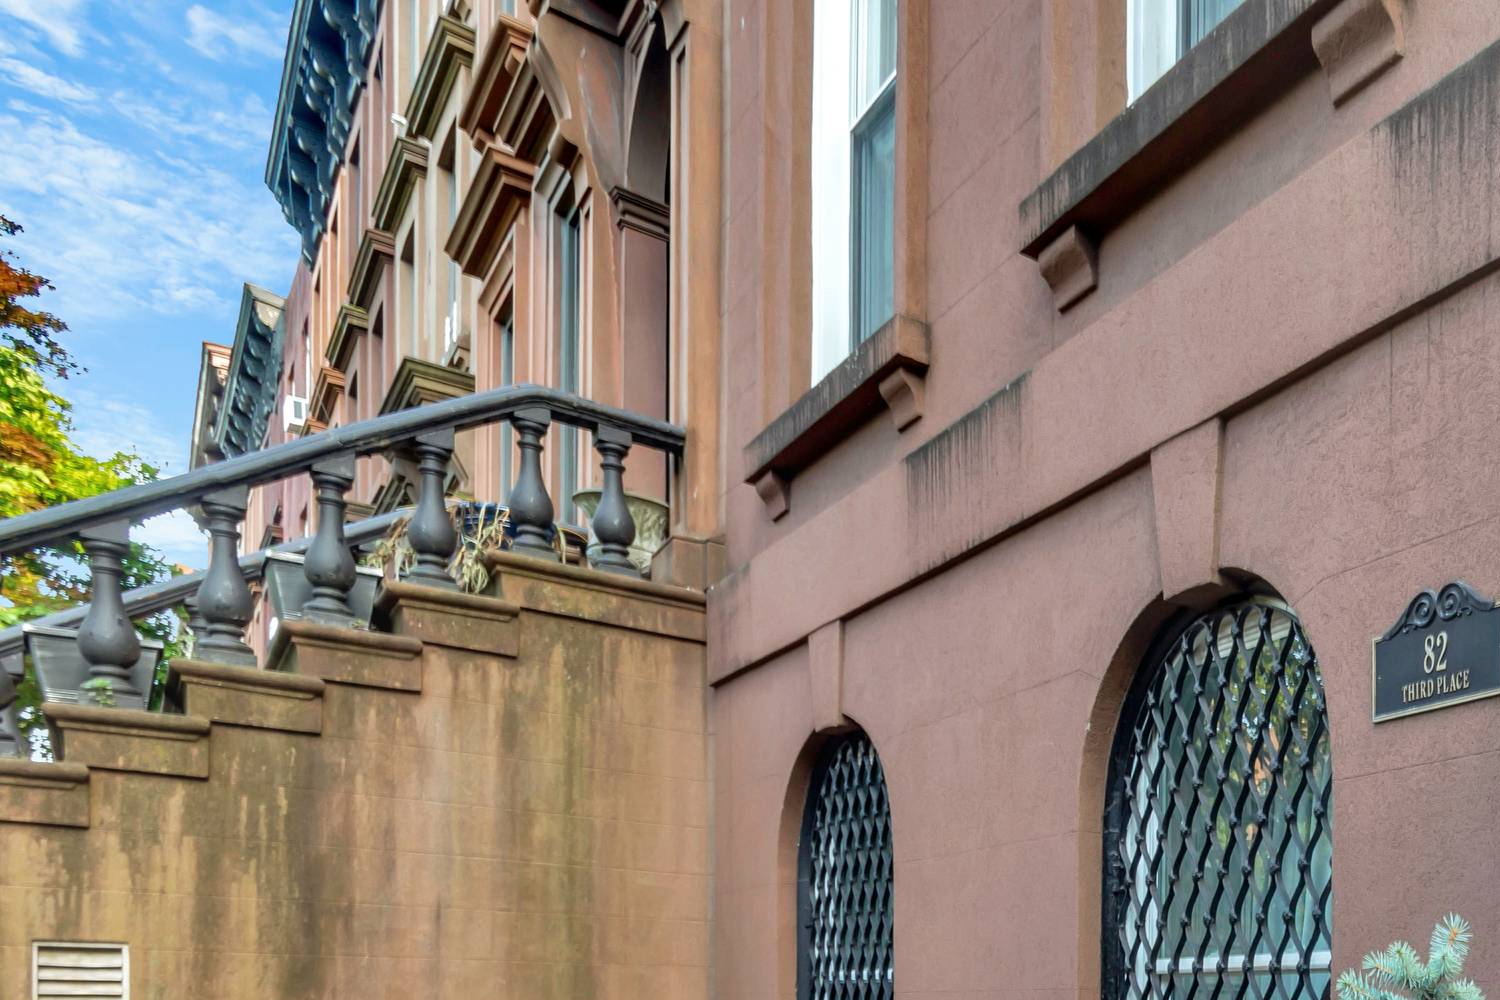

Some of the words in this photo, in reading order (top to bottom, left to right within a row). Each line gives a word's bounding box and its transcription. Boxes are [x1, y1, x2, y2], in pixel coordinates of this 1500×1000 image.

[1423, 631, 1448, 674] 82
[1402, 678, 1434, 703] THIRD
[1437, 669, 1470, 695] PLACE
